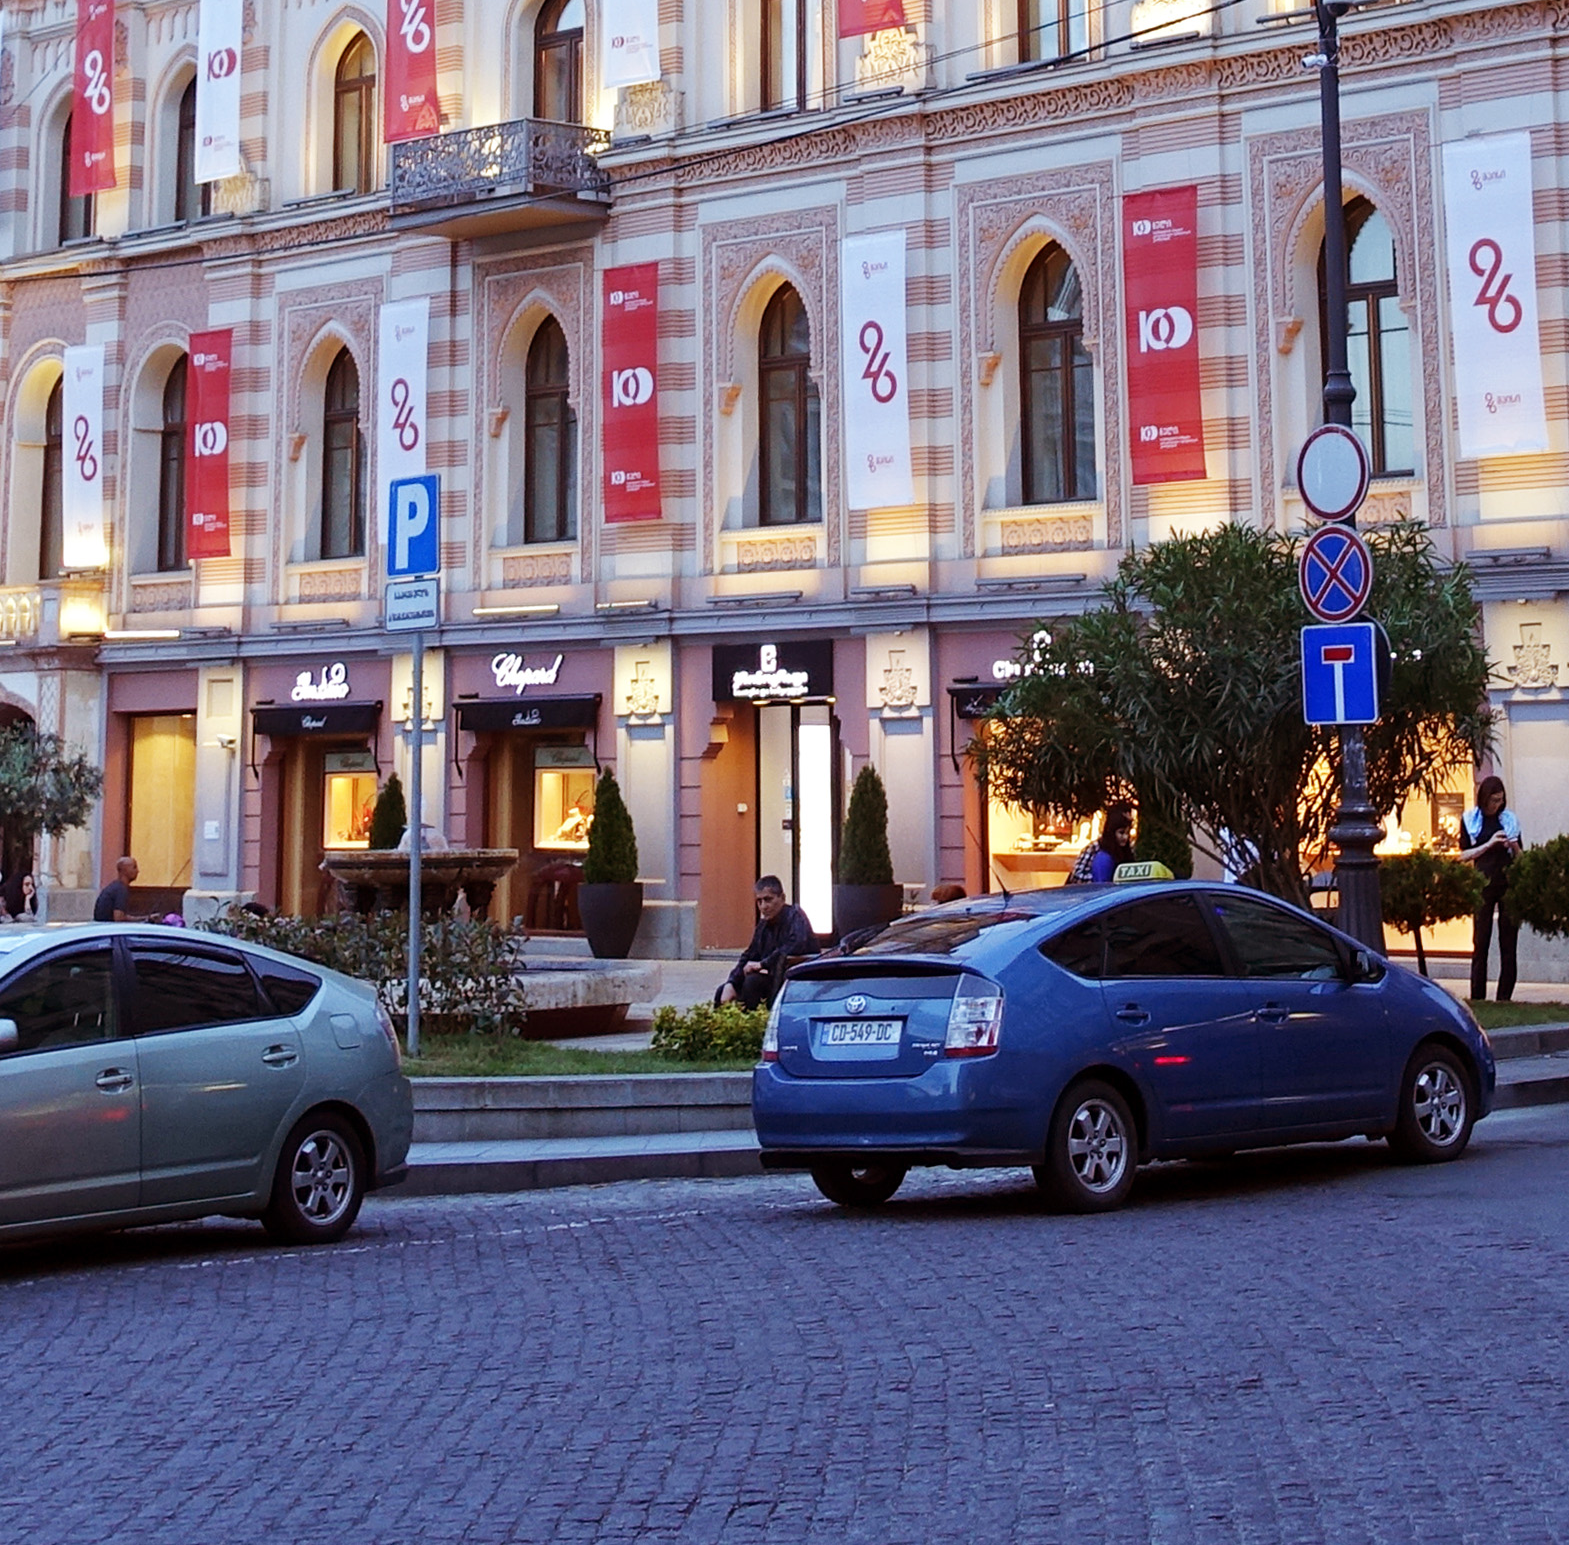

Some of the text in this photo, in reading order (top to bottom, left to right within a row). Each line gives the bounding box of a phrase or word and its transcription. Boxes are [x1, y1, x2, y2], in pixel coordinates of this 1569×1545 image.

[84, 50, 111, 115] 26
[207, 47, 238, 83] 100
[1468, 238, 1524, 335] 26
[1138, 306, 1195, 353] 100
[858, 321, 898, 404] 26
[612, 366, 655, 408] 100
[391, 378, 420, 452] 26
[74, 415, 98, 482] 26
[194, 421, 229, 458] 100
[395, 483, 430, 570] P
[492, 653, 565, 695] Chopard
[1121, 865, 1150, 877] TAXI
[831, 1023, 893, 1042] CD-549-DC
